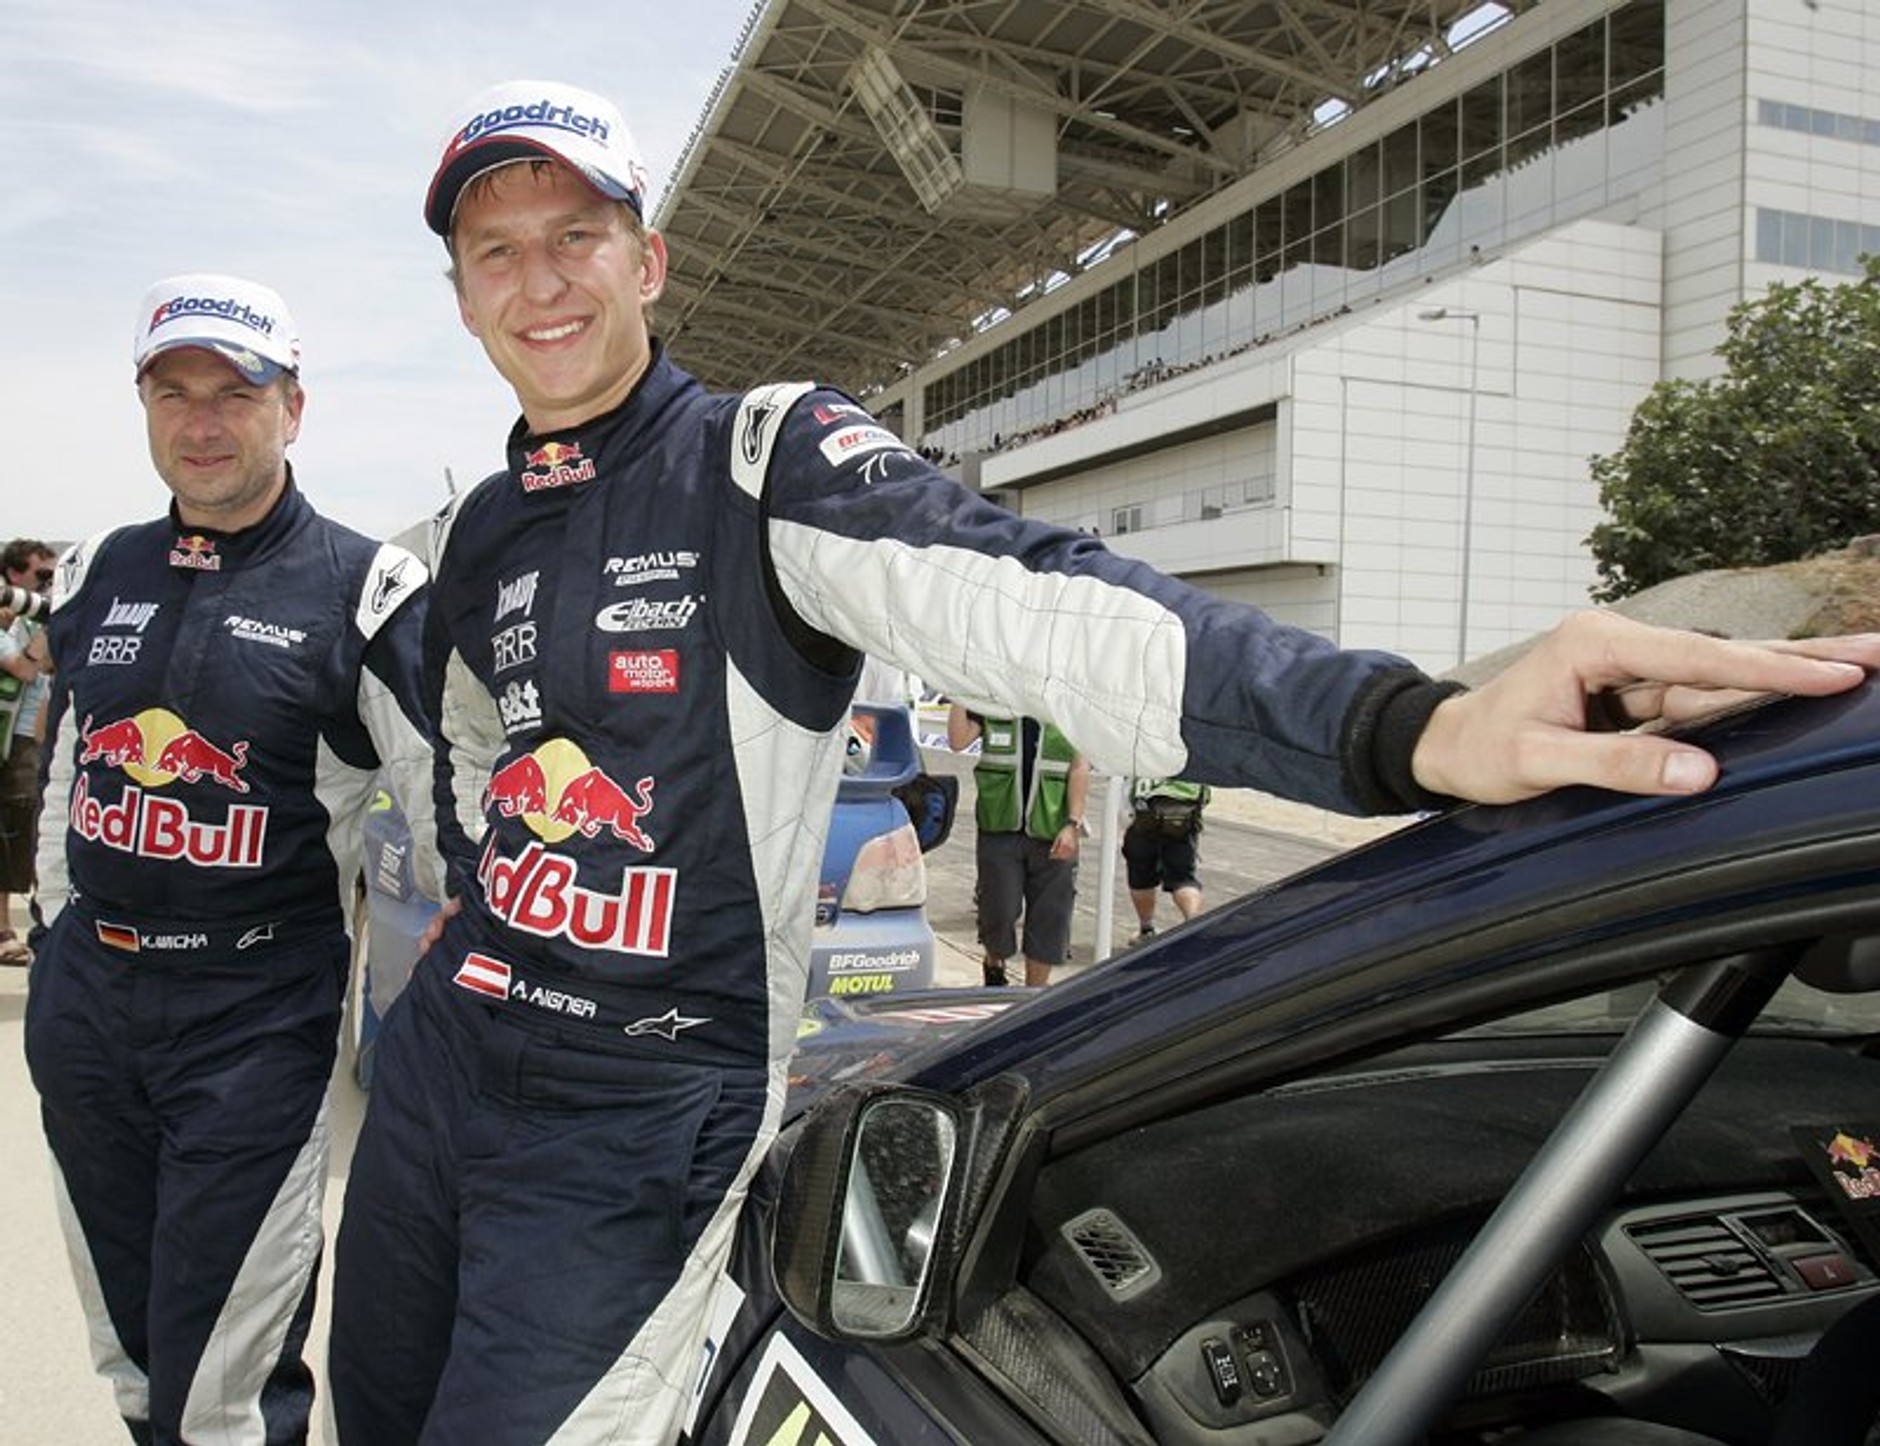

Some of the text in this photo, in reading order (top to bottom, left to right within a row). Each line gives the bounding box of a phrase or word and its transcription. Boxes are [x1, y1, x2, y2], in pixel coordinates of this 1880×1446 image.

[602, 552, 698, 574] REMUS
[223, 616, 304, 643] REMUS
[87, 636, 142, 666] BRR
[615, 655, 663, 669] auto
[622, 668, 672, 679] motor
[828, 951, 920, 970] BFGoodrich
[829, 975, 894, 995] MOTUL
